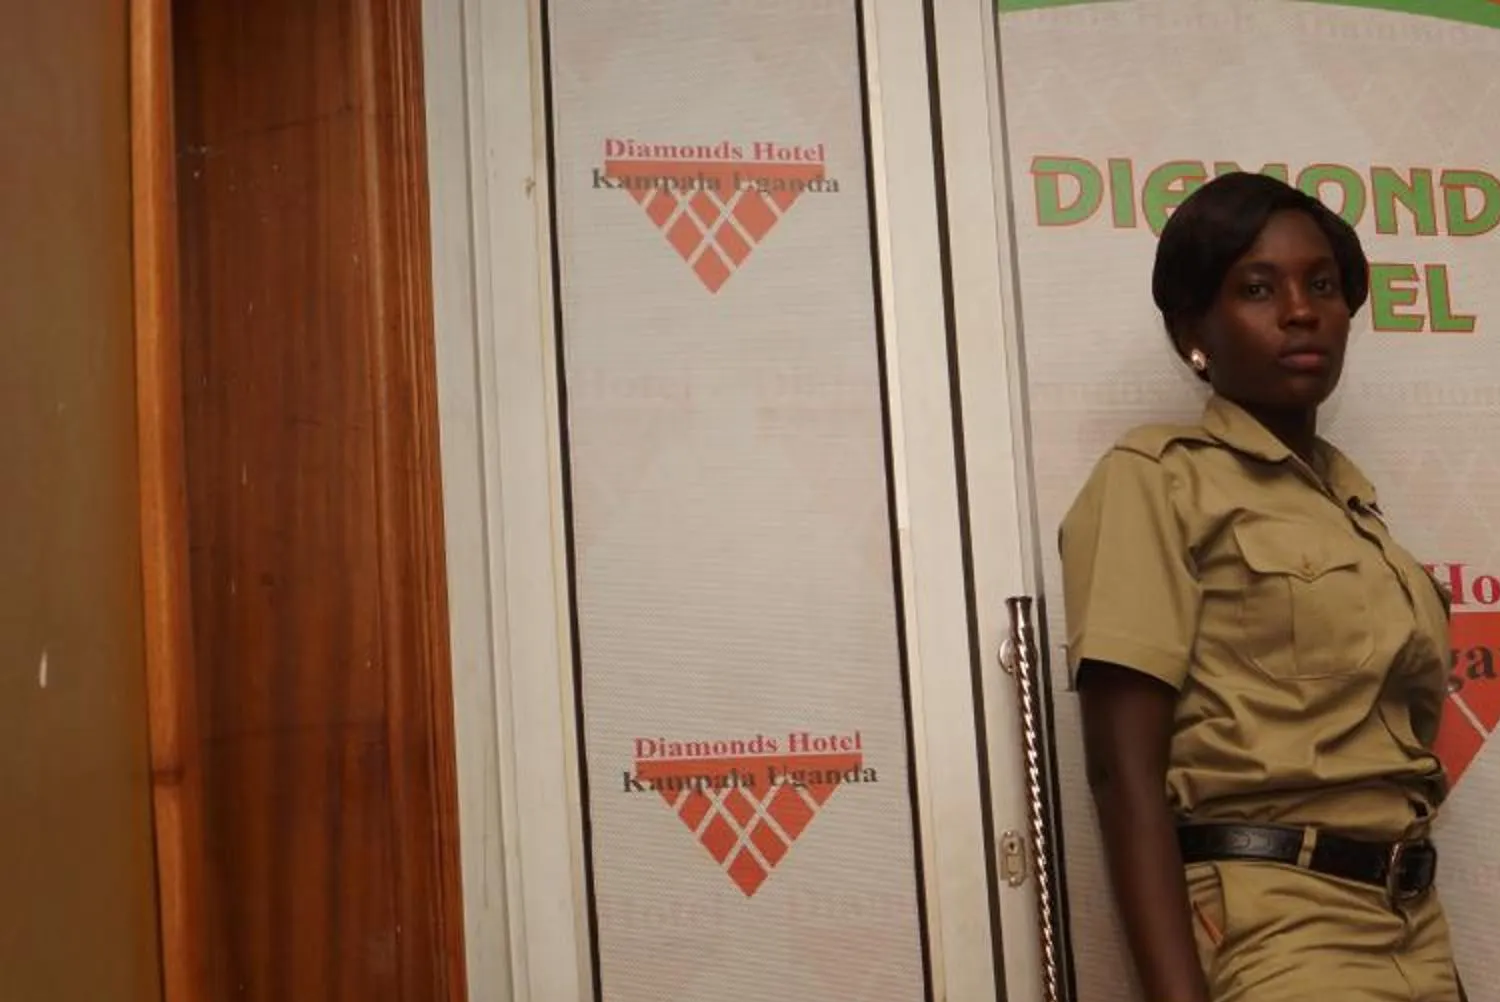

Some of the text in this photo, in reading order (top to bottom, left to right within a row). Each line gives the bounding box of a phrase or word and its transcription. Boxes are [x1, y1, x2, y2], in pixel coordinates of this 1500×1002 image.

[605, 138, 825, 162] Diamonds Hotel
[592, 168, 840, 195] Kampala Uganda
[634, 730, 862, 759] Diamonds Hotel
[622, 763, 880, 793] Kampala Uganda
